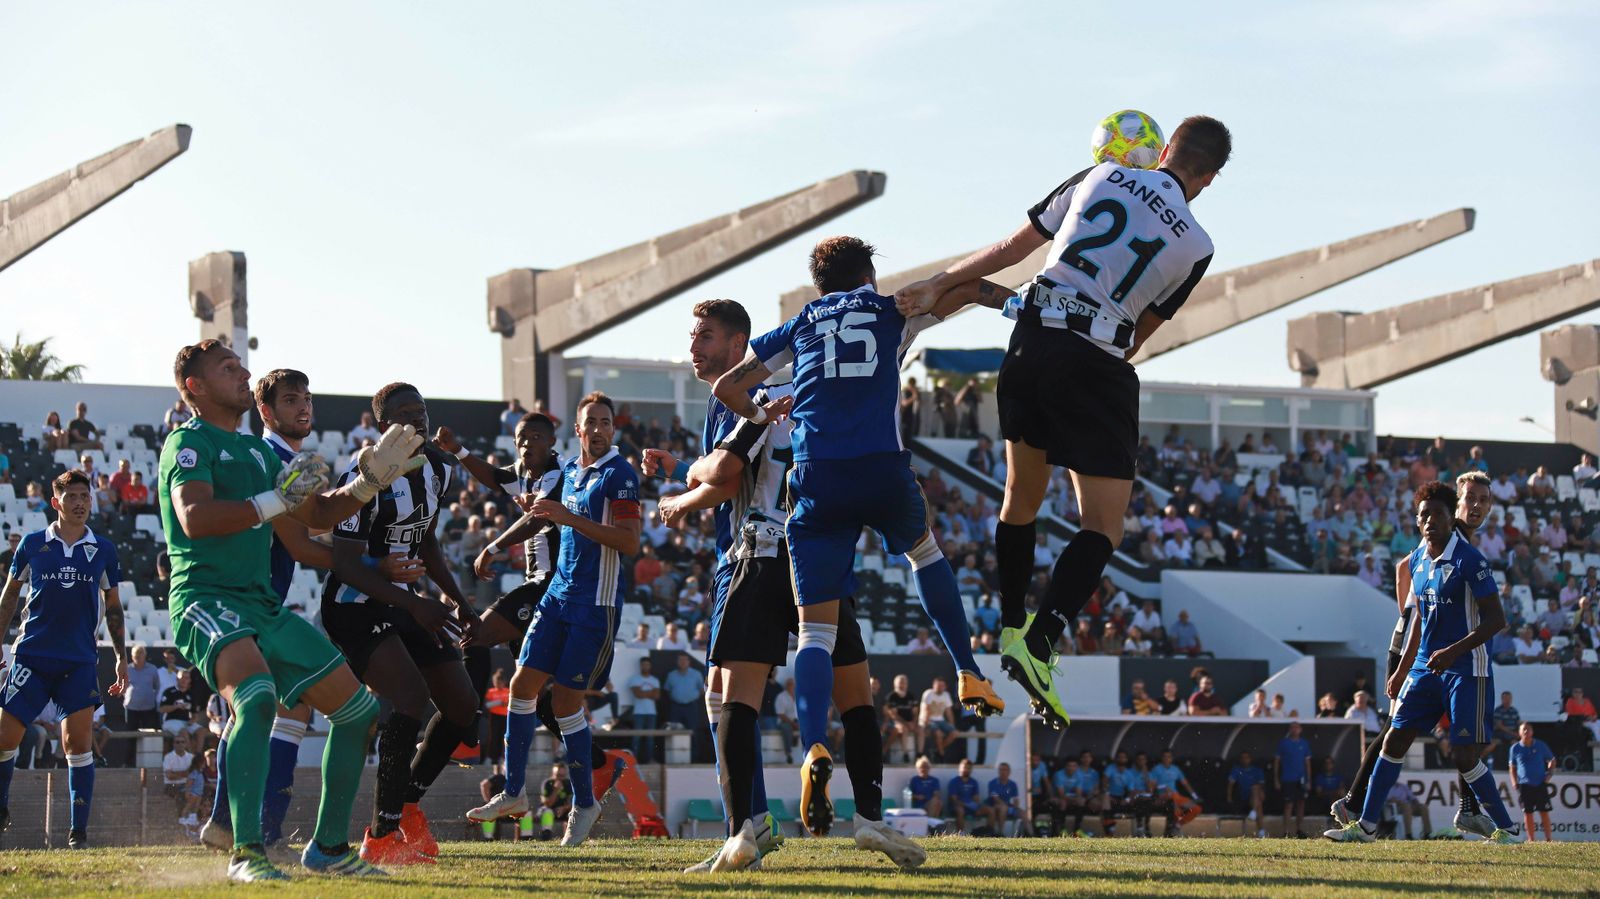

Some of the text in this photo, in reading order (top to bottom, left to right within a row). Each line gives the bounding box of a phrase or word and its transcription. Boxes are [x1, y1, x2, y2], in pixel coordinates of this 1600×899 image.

[1106, 170, 1189, 238] DANESE
[1059, 197, 1167, 304] 21
[1036, 286, 1052, 308] LA
[815, 311, 879, 378] 15
[41, 573, 94, 583] MARBELLA
[14, 663, 32, 687] 18
